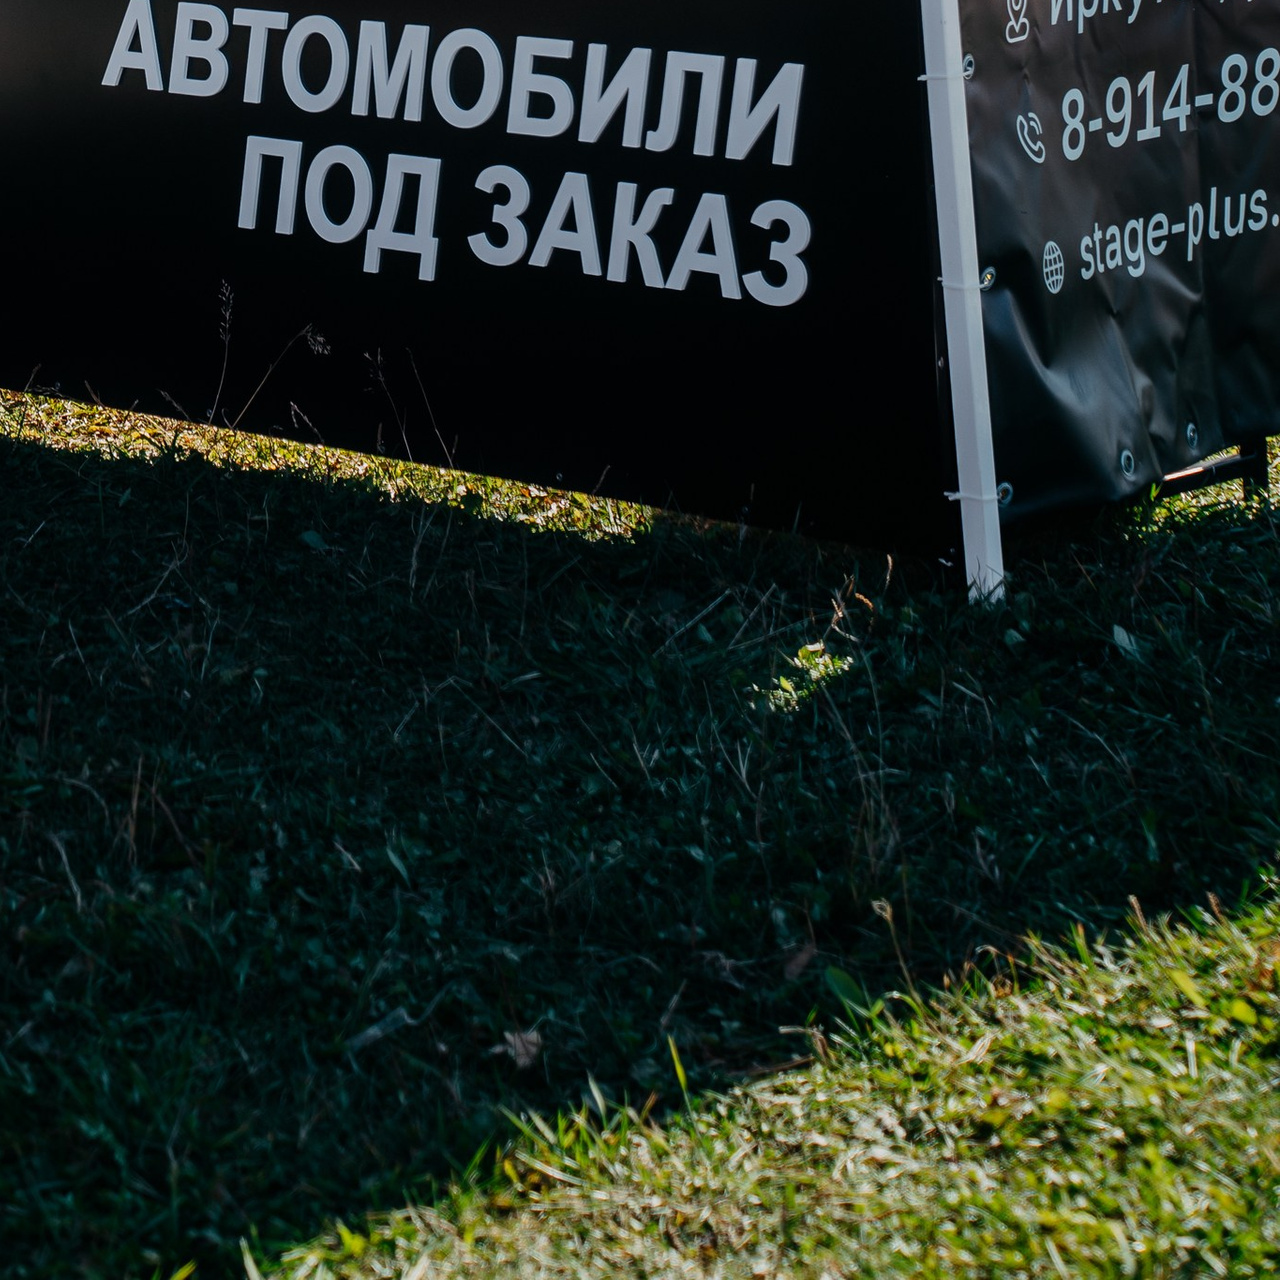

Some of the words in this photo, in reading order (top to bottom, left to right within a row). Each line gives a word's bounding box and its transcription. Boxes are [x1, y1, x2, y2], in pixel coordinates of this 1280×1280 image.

[1062, 47, 1280, 162] 8-914-88
[238, 135, 441, 282] ПОД
[467, 165, 811, 307] ЗАКАЗ
[1080, 186, 1280, 278] stage-plus.
